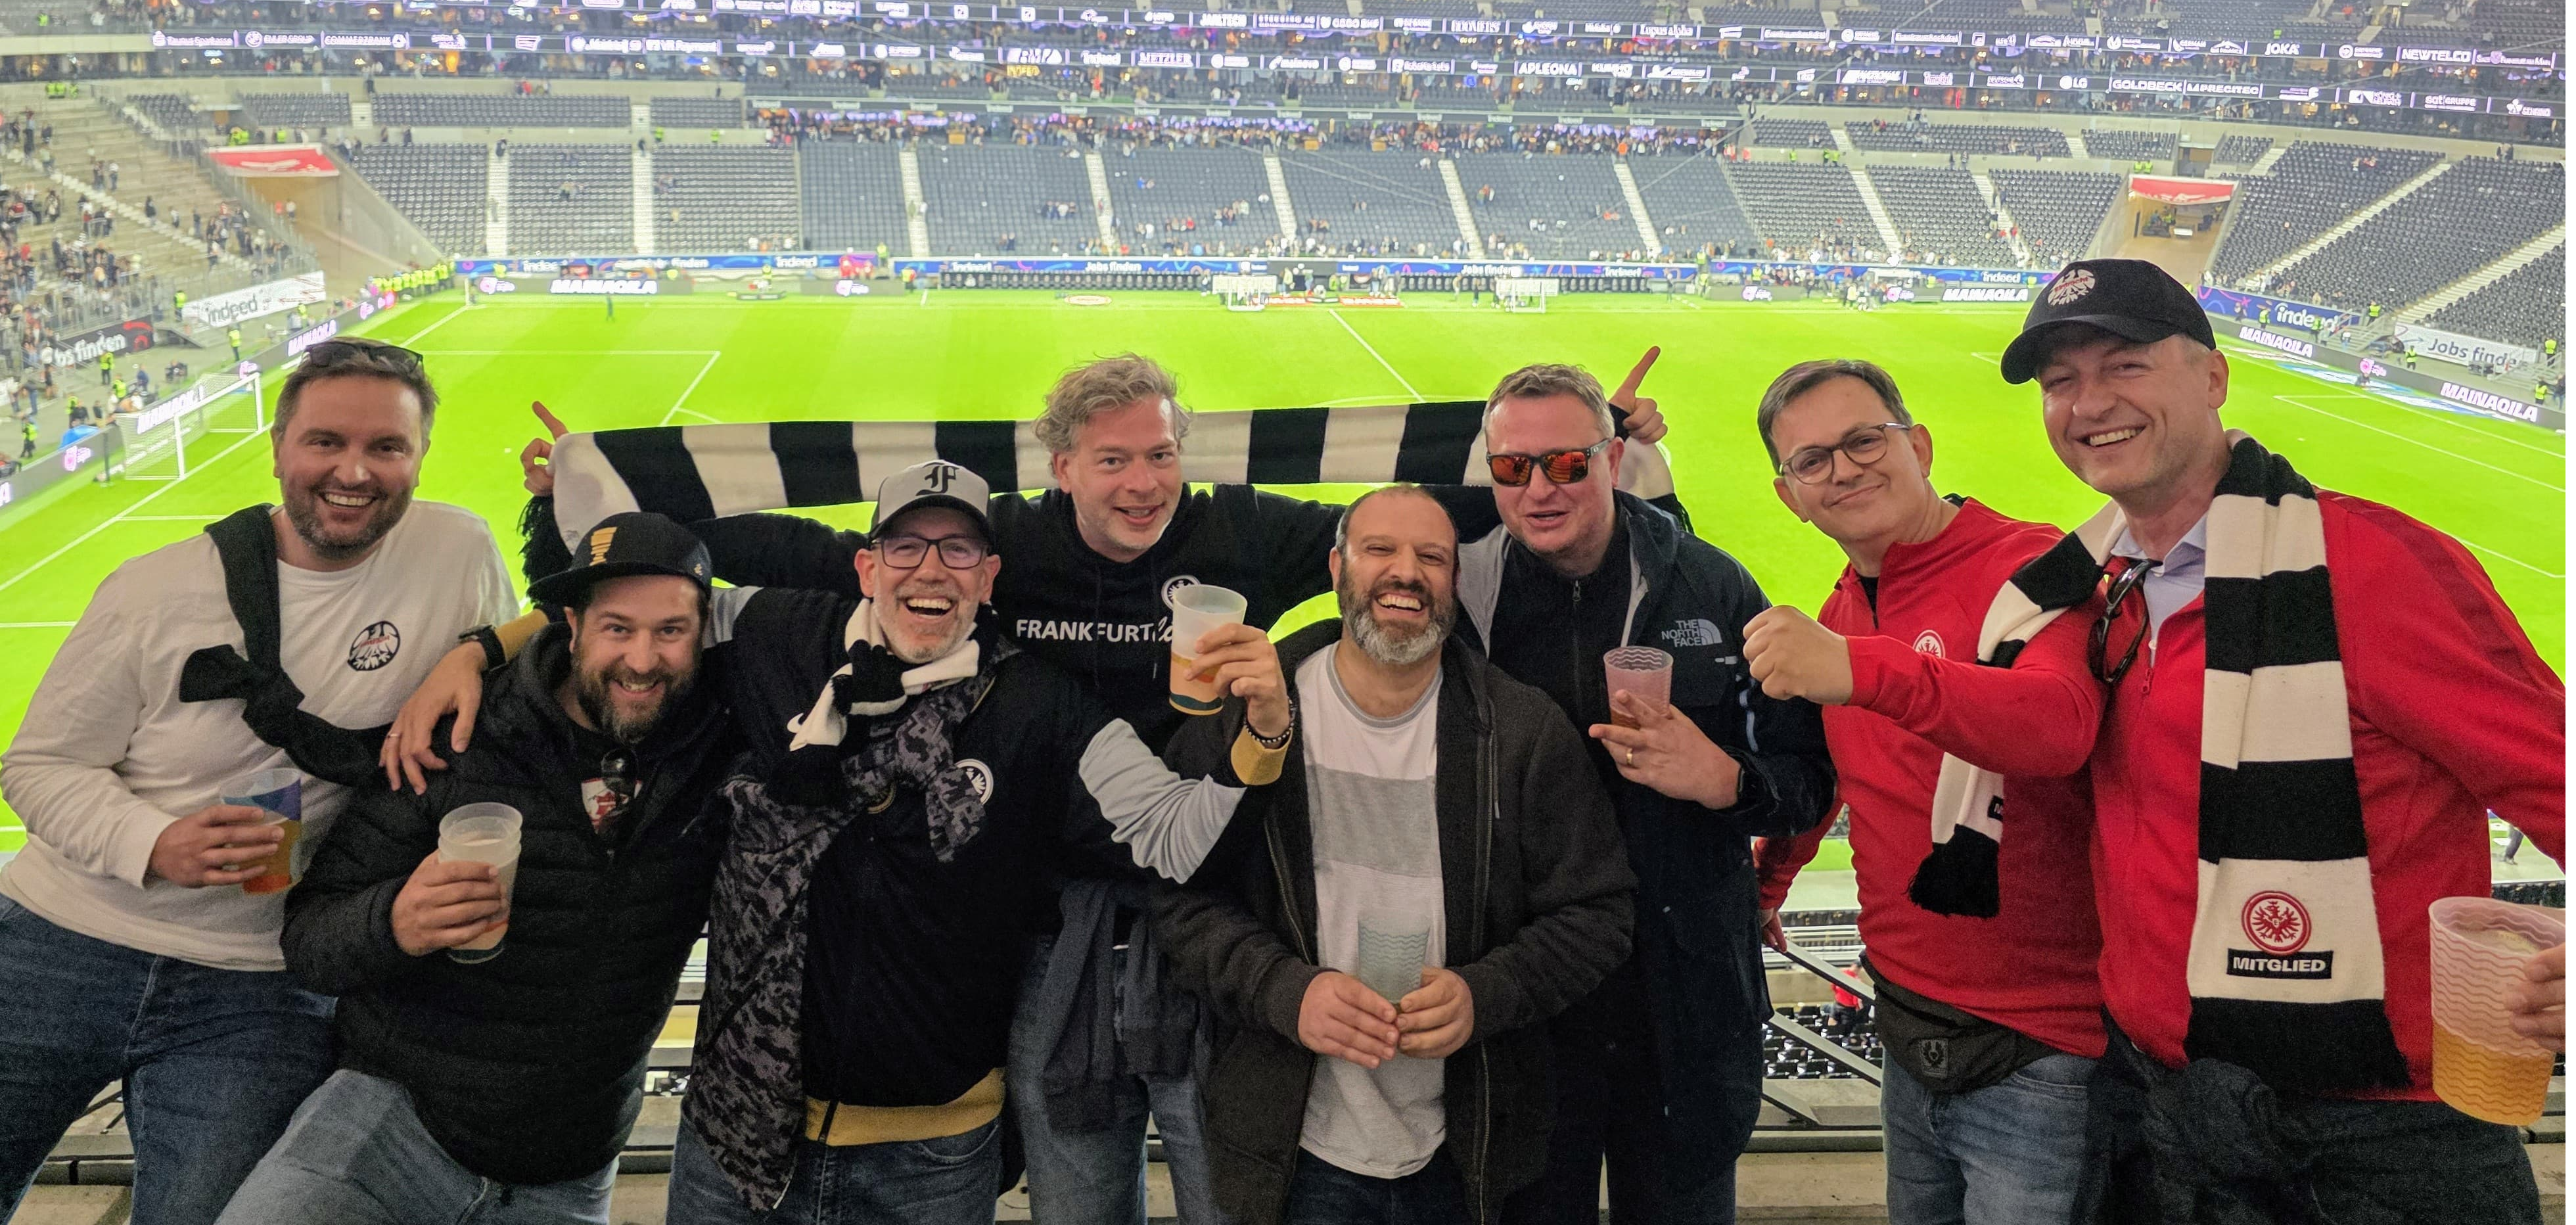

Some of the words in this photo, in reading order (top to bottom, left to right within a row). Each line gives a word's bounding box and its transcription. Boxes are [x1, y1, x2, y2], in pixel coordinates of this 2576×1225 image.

[324, 36, 392, 45] COMMERZBANK
[2265, 43, 2299, 55] JOKA
[2401, 49, 2472, 62] NEWTELCO
[1518, 62, 1578, 76] APLEONA
[2073, 77, 2088, 89] LG
[2112, 80, 2182, 92] GOLDBECK
[2199, 84, 2259, 95] PRECITEC
[1983, 272, 2021, 285] indeed
[206, 294, 258, 323] indeed
[2276, 306, 2339, 333] inded
[2239, 326, 2313, 358] MAINAQILA
[2427, 338, 2468, 358] Jobs
[2440, 382, 2539, 423] MAINAQILA
[1016, 618, 1155, 643] FRANKFURT
[1675, 619, 1699, 630] THE
[1661, 628, 1700, 640] NORTH
[1674, 637, 1702, 647] FACE
[2232, 956, 2327, 973] MITGLIED
